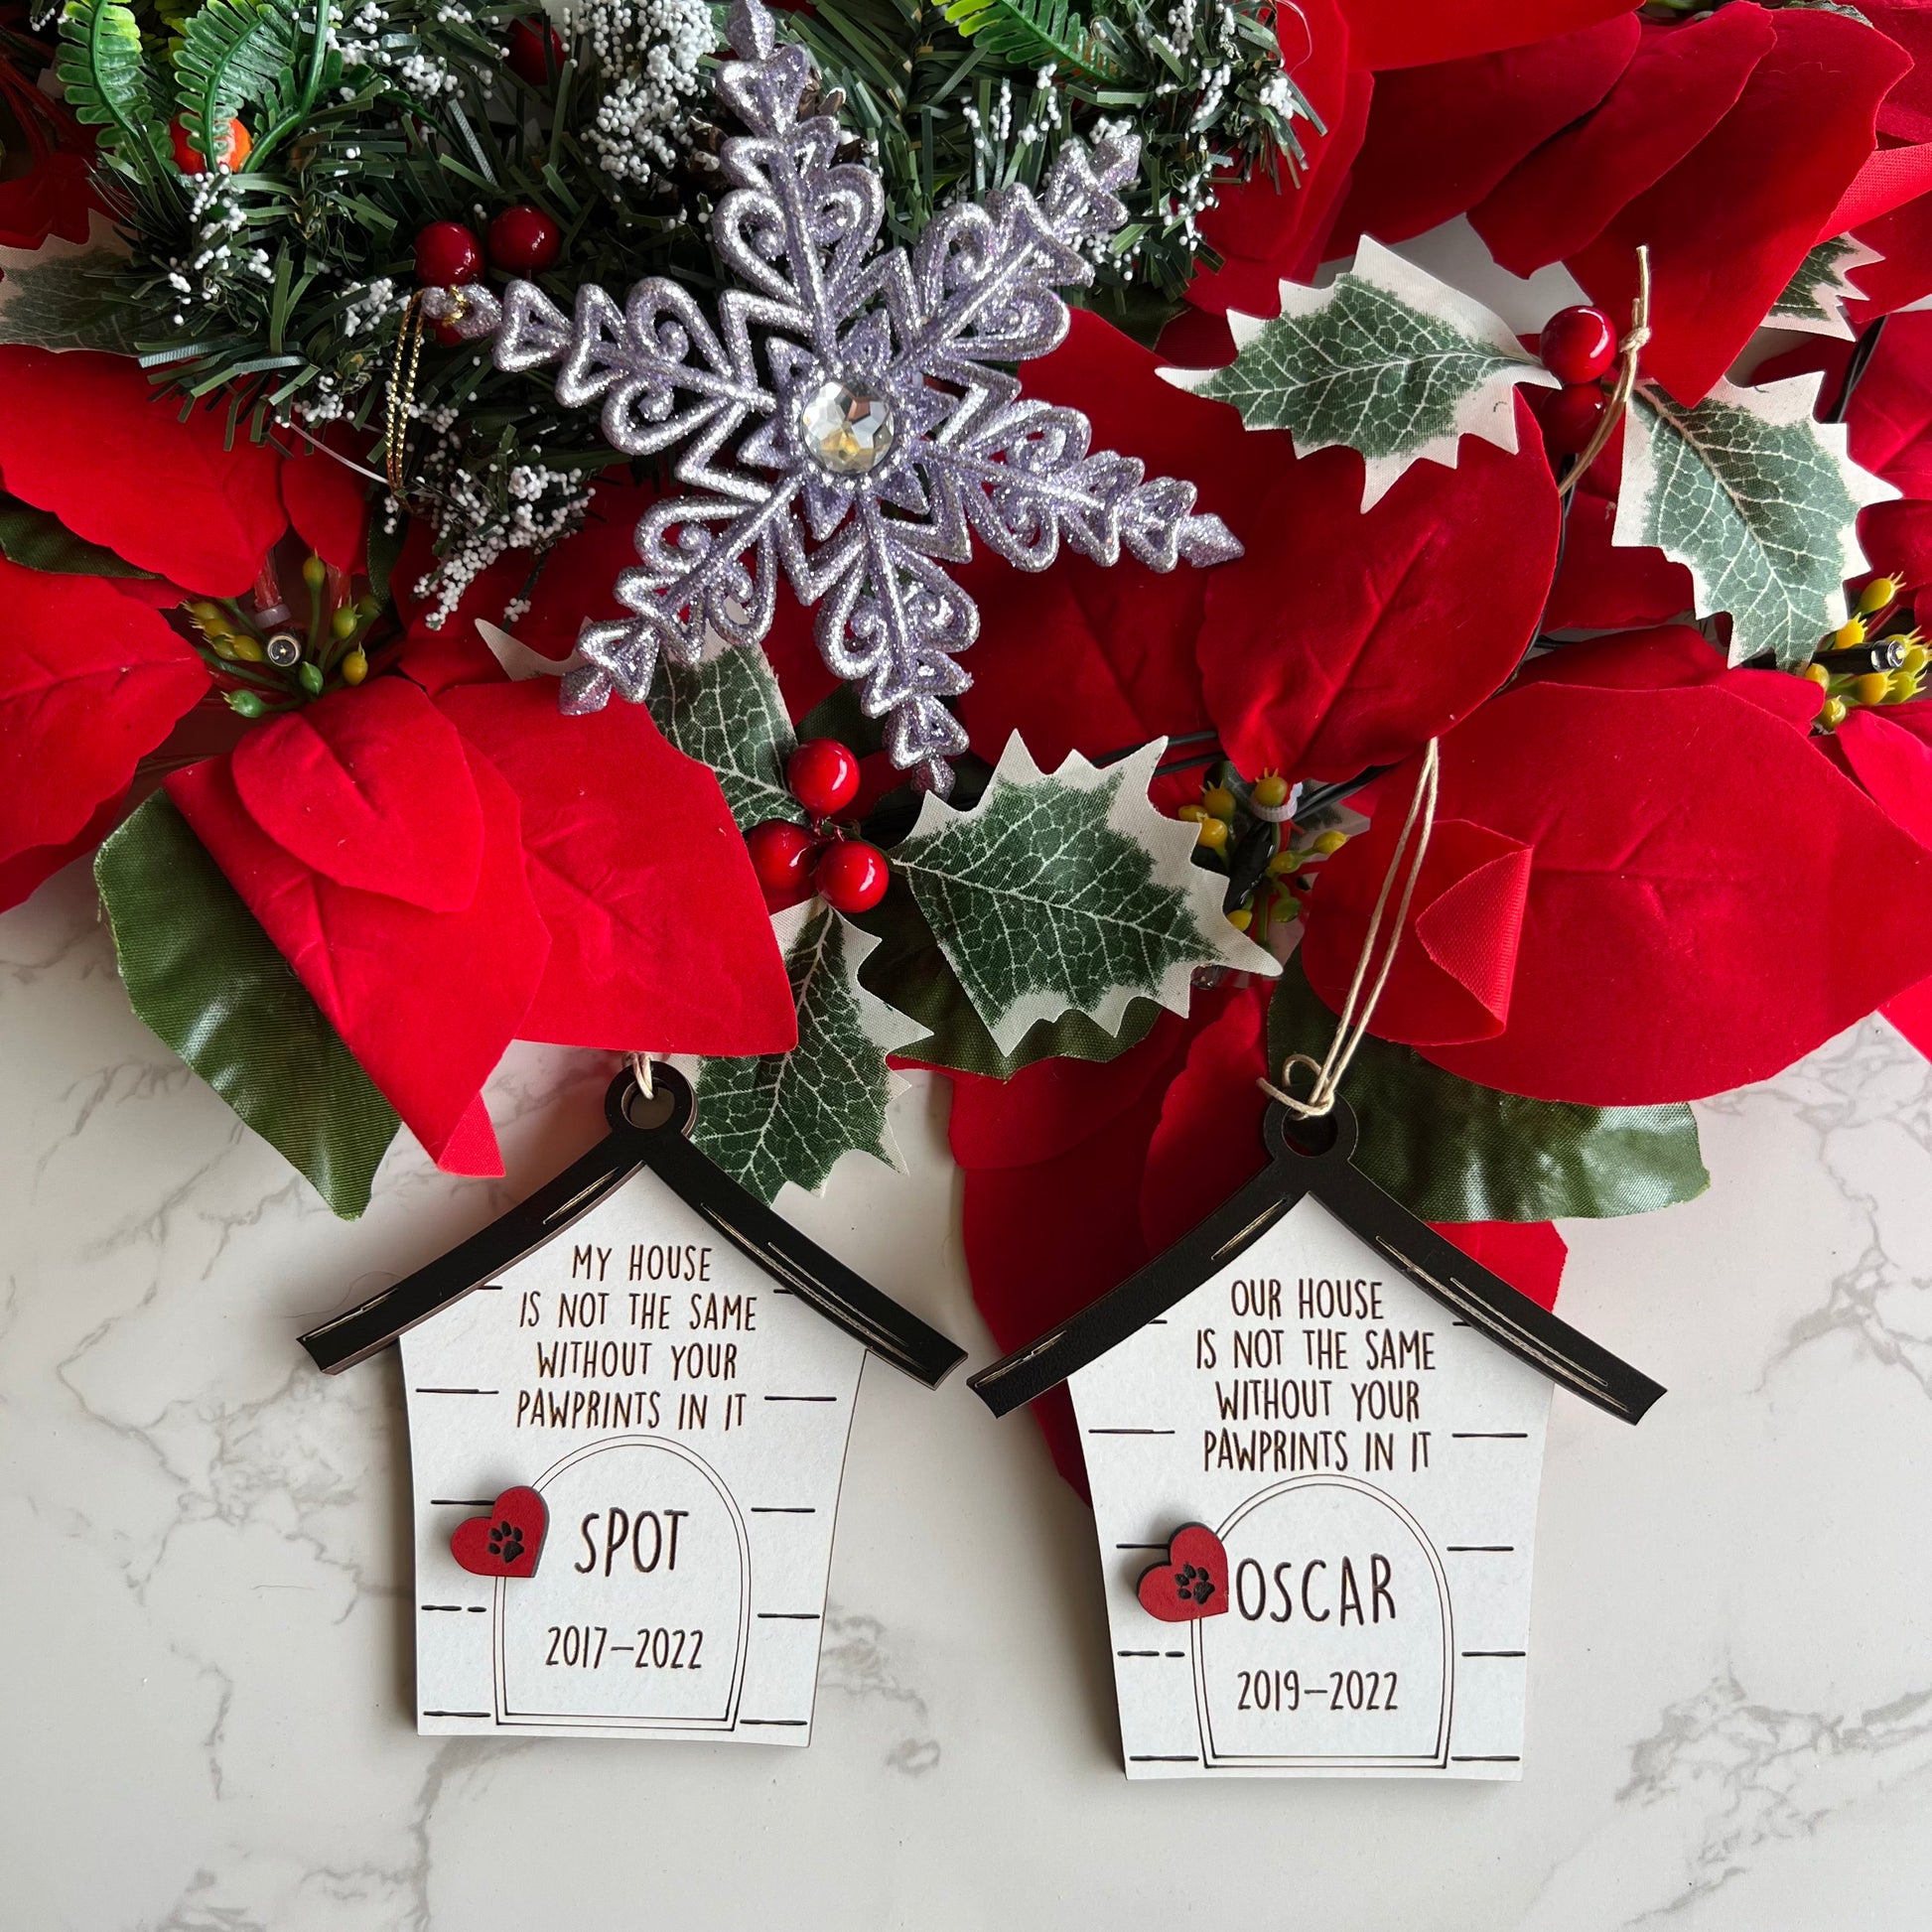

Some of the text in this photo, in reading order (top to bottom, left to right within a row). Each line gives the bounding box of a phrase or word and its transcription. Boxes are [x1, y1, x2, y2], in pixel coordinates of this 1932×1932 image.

[573, 1245, 712, 1282] MY HOUSE
[520, 1292, 758, 1331] IS NOT THE SAME
[1232, 1279, 1383, 1320] OUR HOUSE
[537, 1341, 738, 1381] WITHOUT YOUR
[1196, 1328, 1436, 1370] IS NOT THE SAME
[517, 1388, 748, 1432] PAWPRINTS IN IT
[1215, 1379, 1420, 1423] WITHOUT YOUR
[1205, 1428, 1432, 1472] PAWPRINTS IN IT
[575, 1507, 689, 1577] SPOT
[1236, 1554, 1396, 1626] OSCAR
